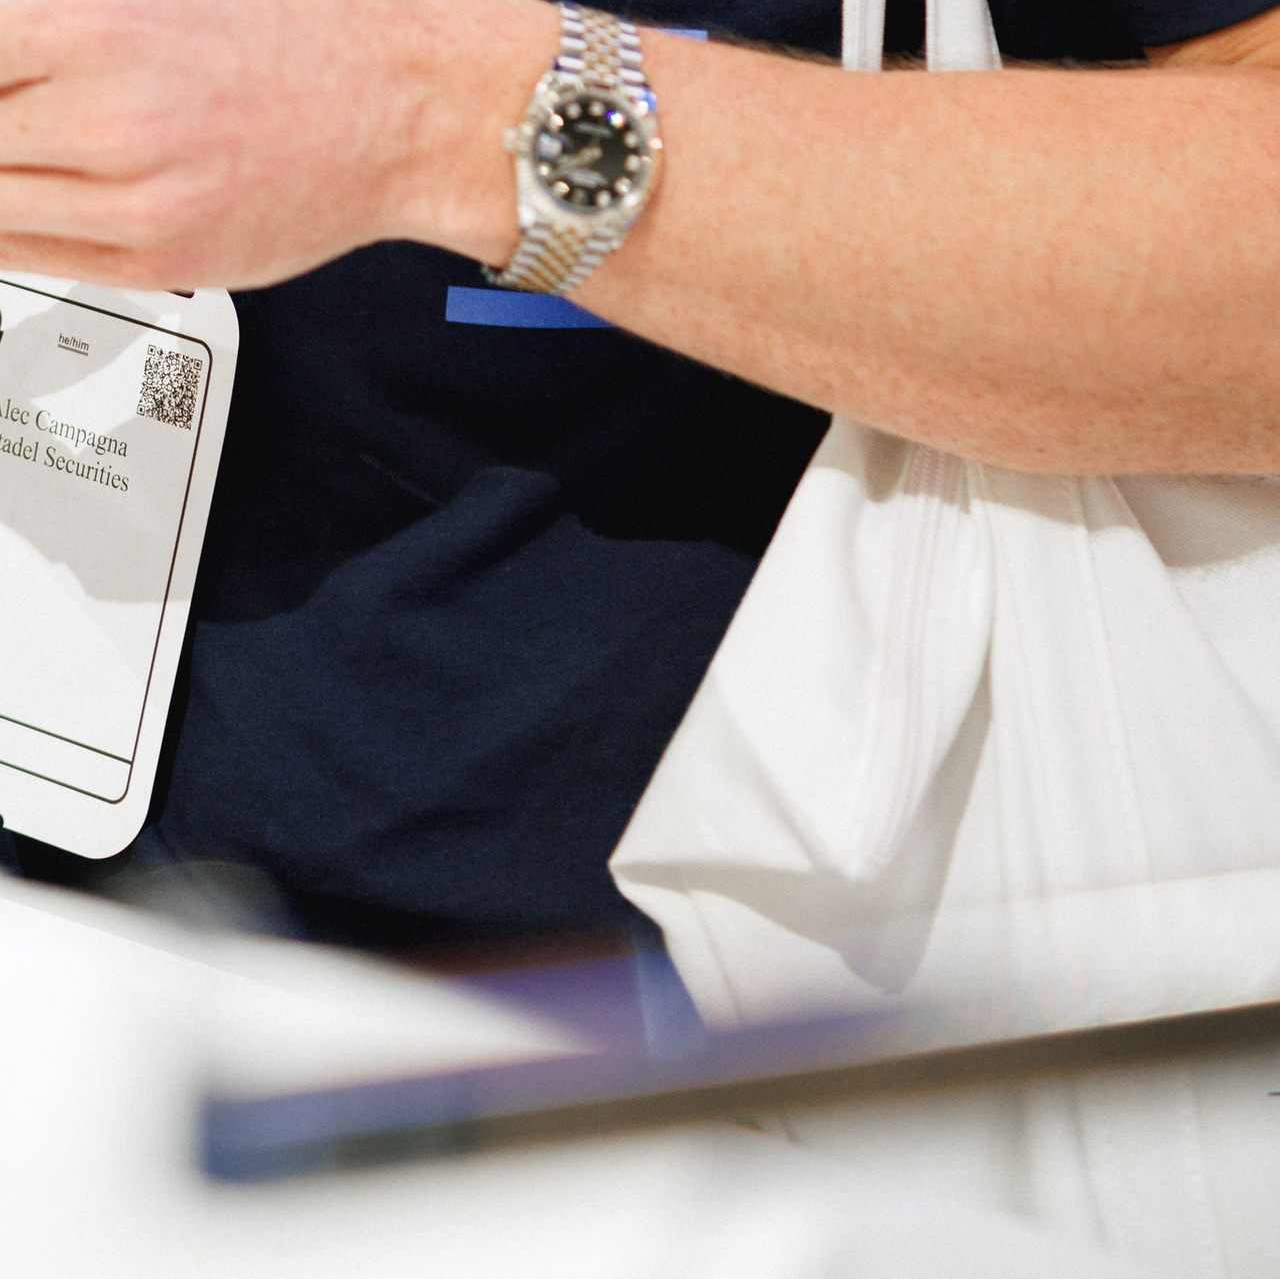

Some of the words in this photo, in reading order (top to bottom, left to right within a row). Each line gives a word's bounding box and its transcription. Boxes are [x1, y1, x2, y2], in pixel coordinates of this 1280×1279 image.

[58, 333, 90, 352] he/him
[35, 409, 128, 458] Campagna
[43, 445, 130, 492] Securities
